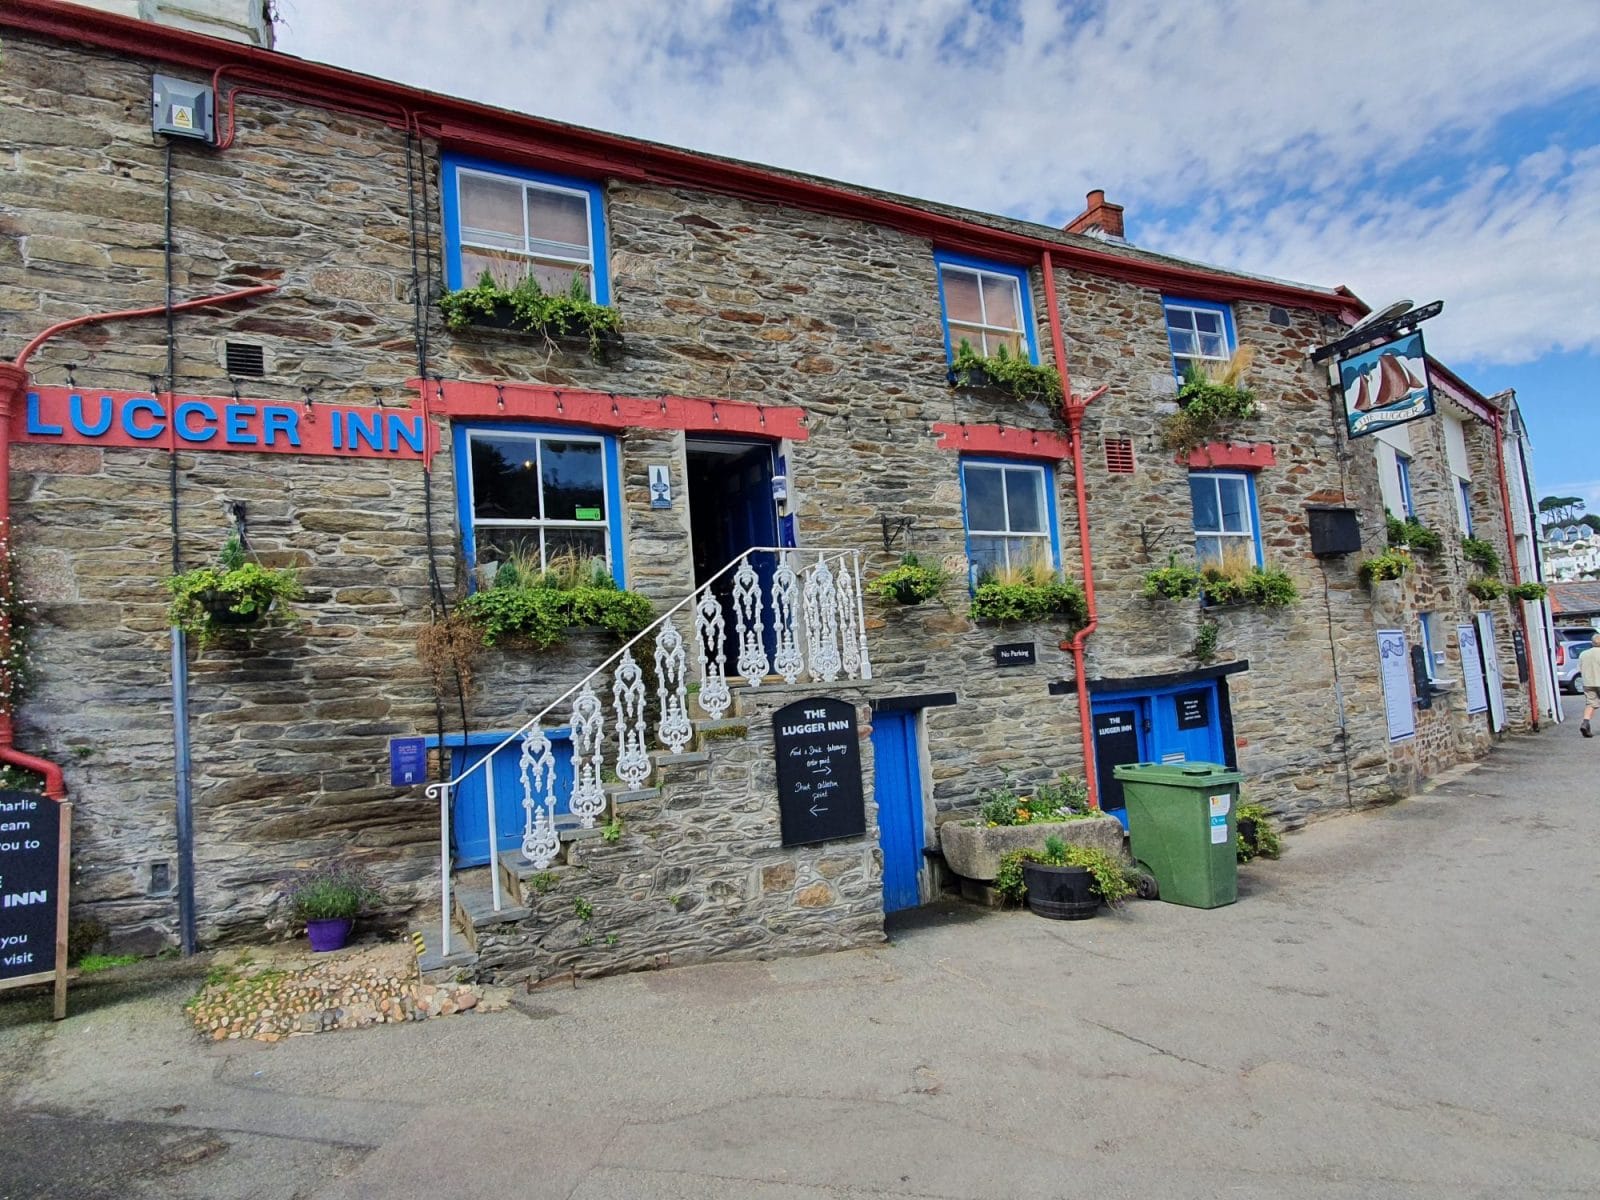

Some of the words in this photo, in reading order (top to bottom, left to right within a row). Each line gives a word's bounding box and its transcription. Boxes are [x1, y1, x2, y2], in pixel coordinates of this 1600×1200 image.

[1359, 414, 1376, 425] THE
[1380, 407, 1419, 420] LUGGER
[332, 410, 423, 452] INN
[1011, 650, 1029, 658] Parking
[804, 709, 826, 720] THE
[1109, 717, 1121, 725] THE
[782, 722, 826, 736] LUGGER
[828, 720, 849, 731] INN
[1099, 726, 1121, 736] LUGGER
[0, 799, 37, 811] harlie
[0, 821, 30, 831] eam
[0, 842, 20, 851] ou
[25, 840, 40, 849] to
[4, 890, 47, 907] INN
[0, 934, 28, 949] you
[4, 952, 34, 966] visit
